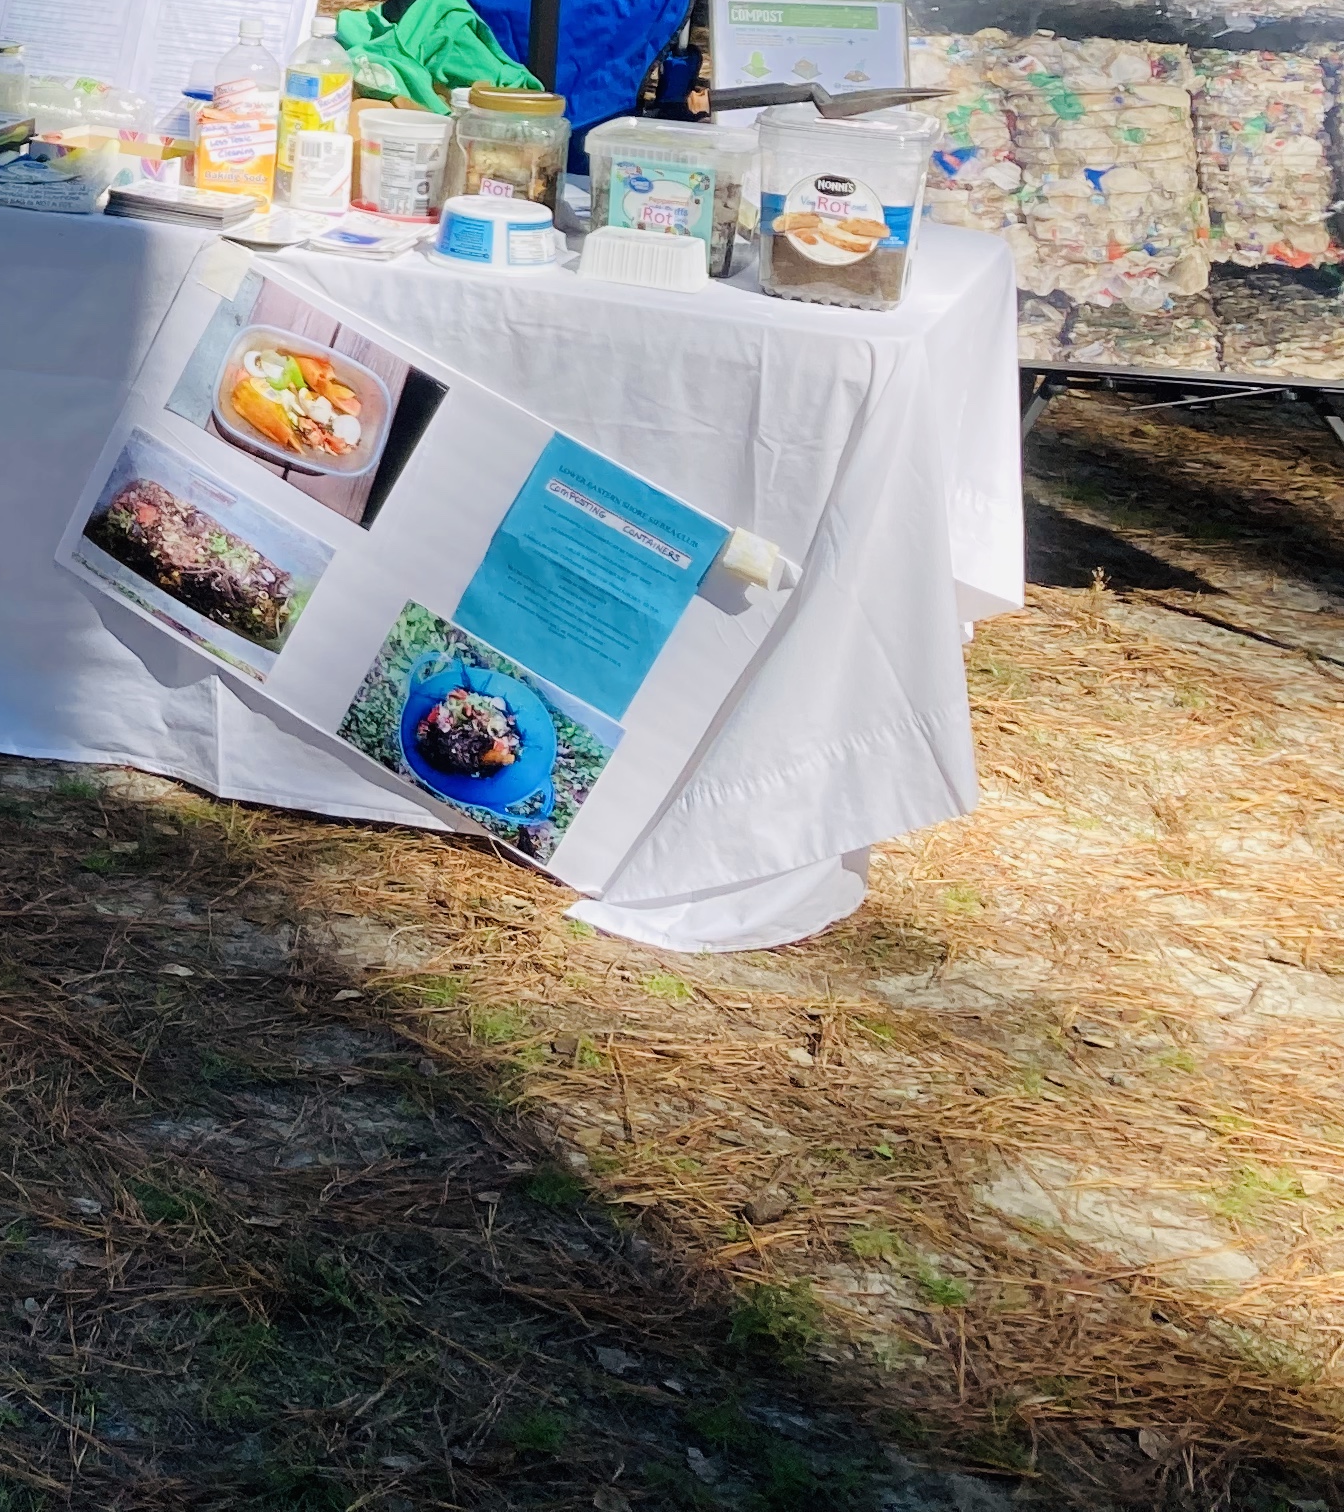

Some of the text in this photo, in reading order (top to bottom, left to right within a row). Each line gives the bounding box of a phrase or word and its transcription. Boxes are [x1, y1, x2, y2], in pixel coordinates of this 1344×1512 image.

[730, 8, 784, 24] COMPOST
[483, 179, 512, 198] Rot
[817, 179, 855, 194] NONNI'S
[817, 196, 850, 215] Rot
[643, 206, 673, 226] Rot
[622, 524, 681, 563] CONTAINERS
